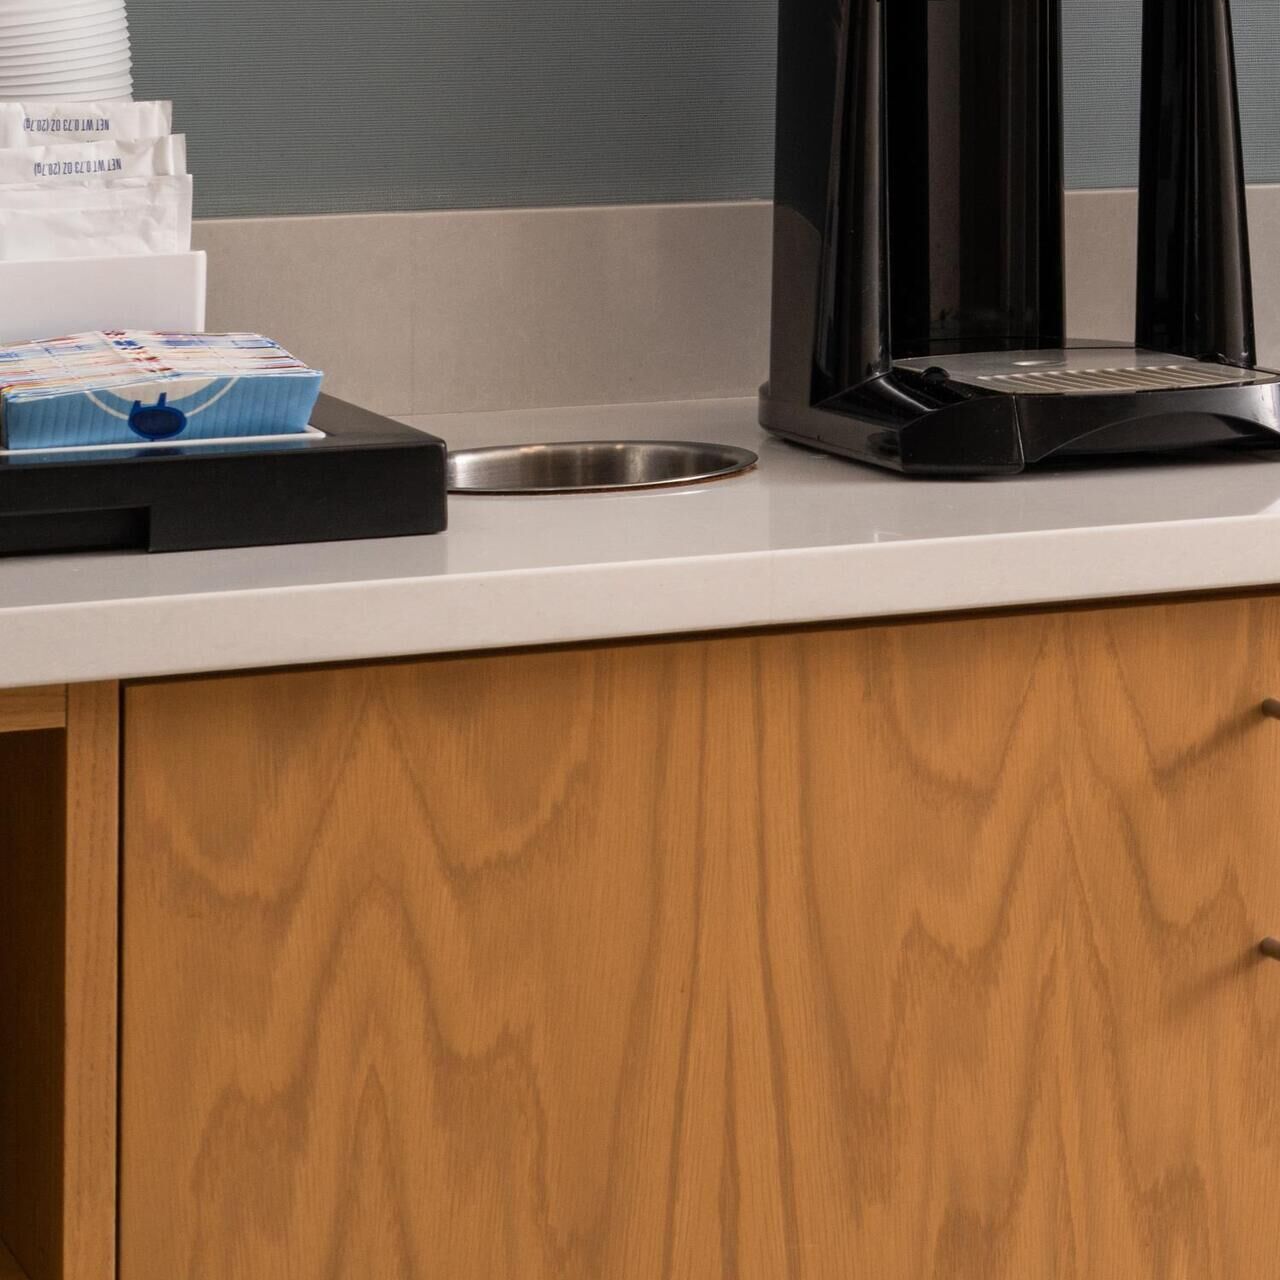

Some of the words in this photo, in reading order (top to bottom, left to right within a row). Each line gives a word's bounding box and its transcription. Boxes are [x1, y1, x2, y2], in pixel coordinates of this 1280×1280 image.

[51, 118, 61, 132] OZ
[63, 118, 80, 131] 0.73
[82, 118, 94, 131] WT
[95, 118, 110, 131] NET
[63, 161, 73, 175] OZ
[75, 160, 90, 174] 0.73
[94, 159, 106, 173] WT
[107, 158, 122, 171] NET
